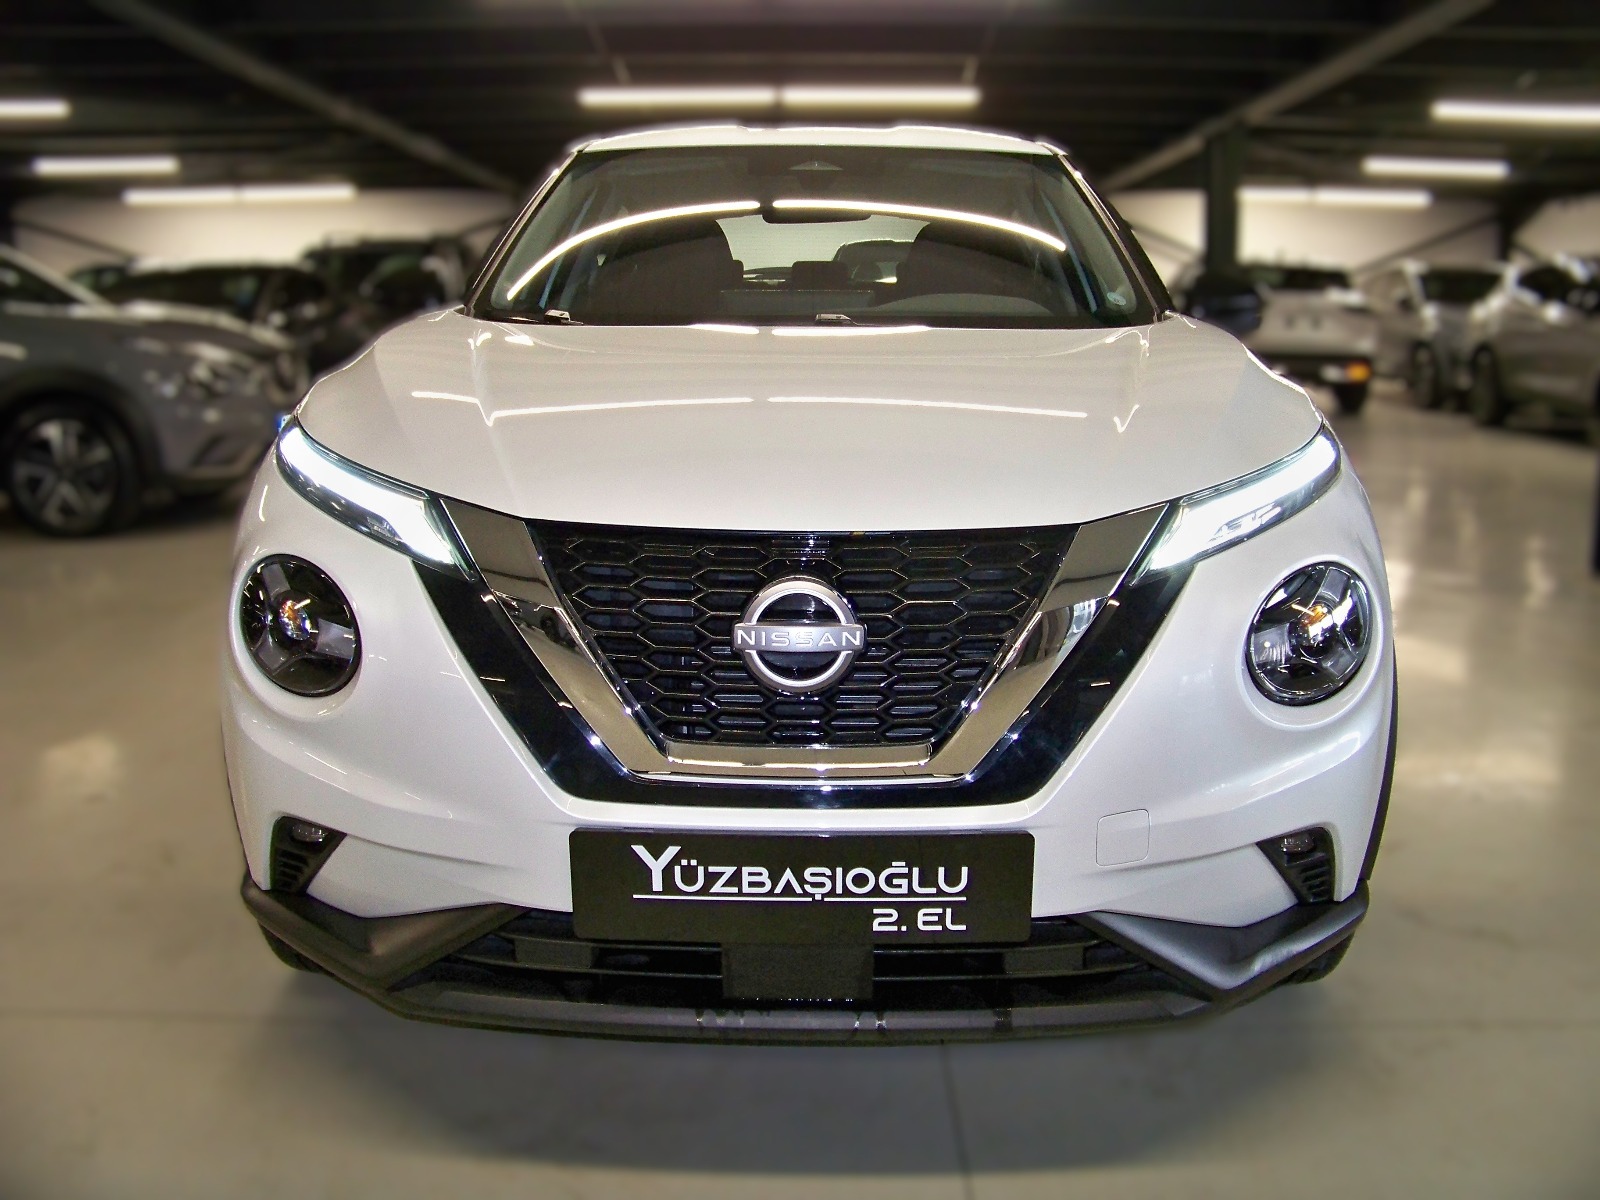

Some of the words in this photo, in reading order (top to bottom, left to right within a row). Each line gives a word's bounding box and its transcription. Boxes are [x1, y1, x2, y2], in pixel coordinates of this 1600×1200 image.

[737, 629, 861, 647] NISSAN
[872, 908, 907, 932] 2.
[917, 907, 967, 931] EL
